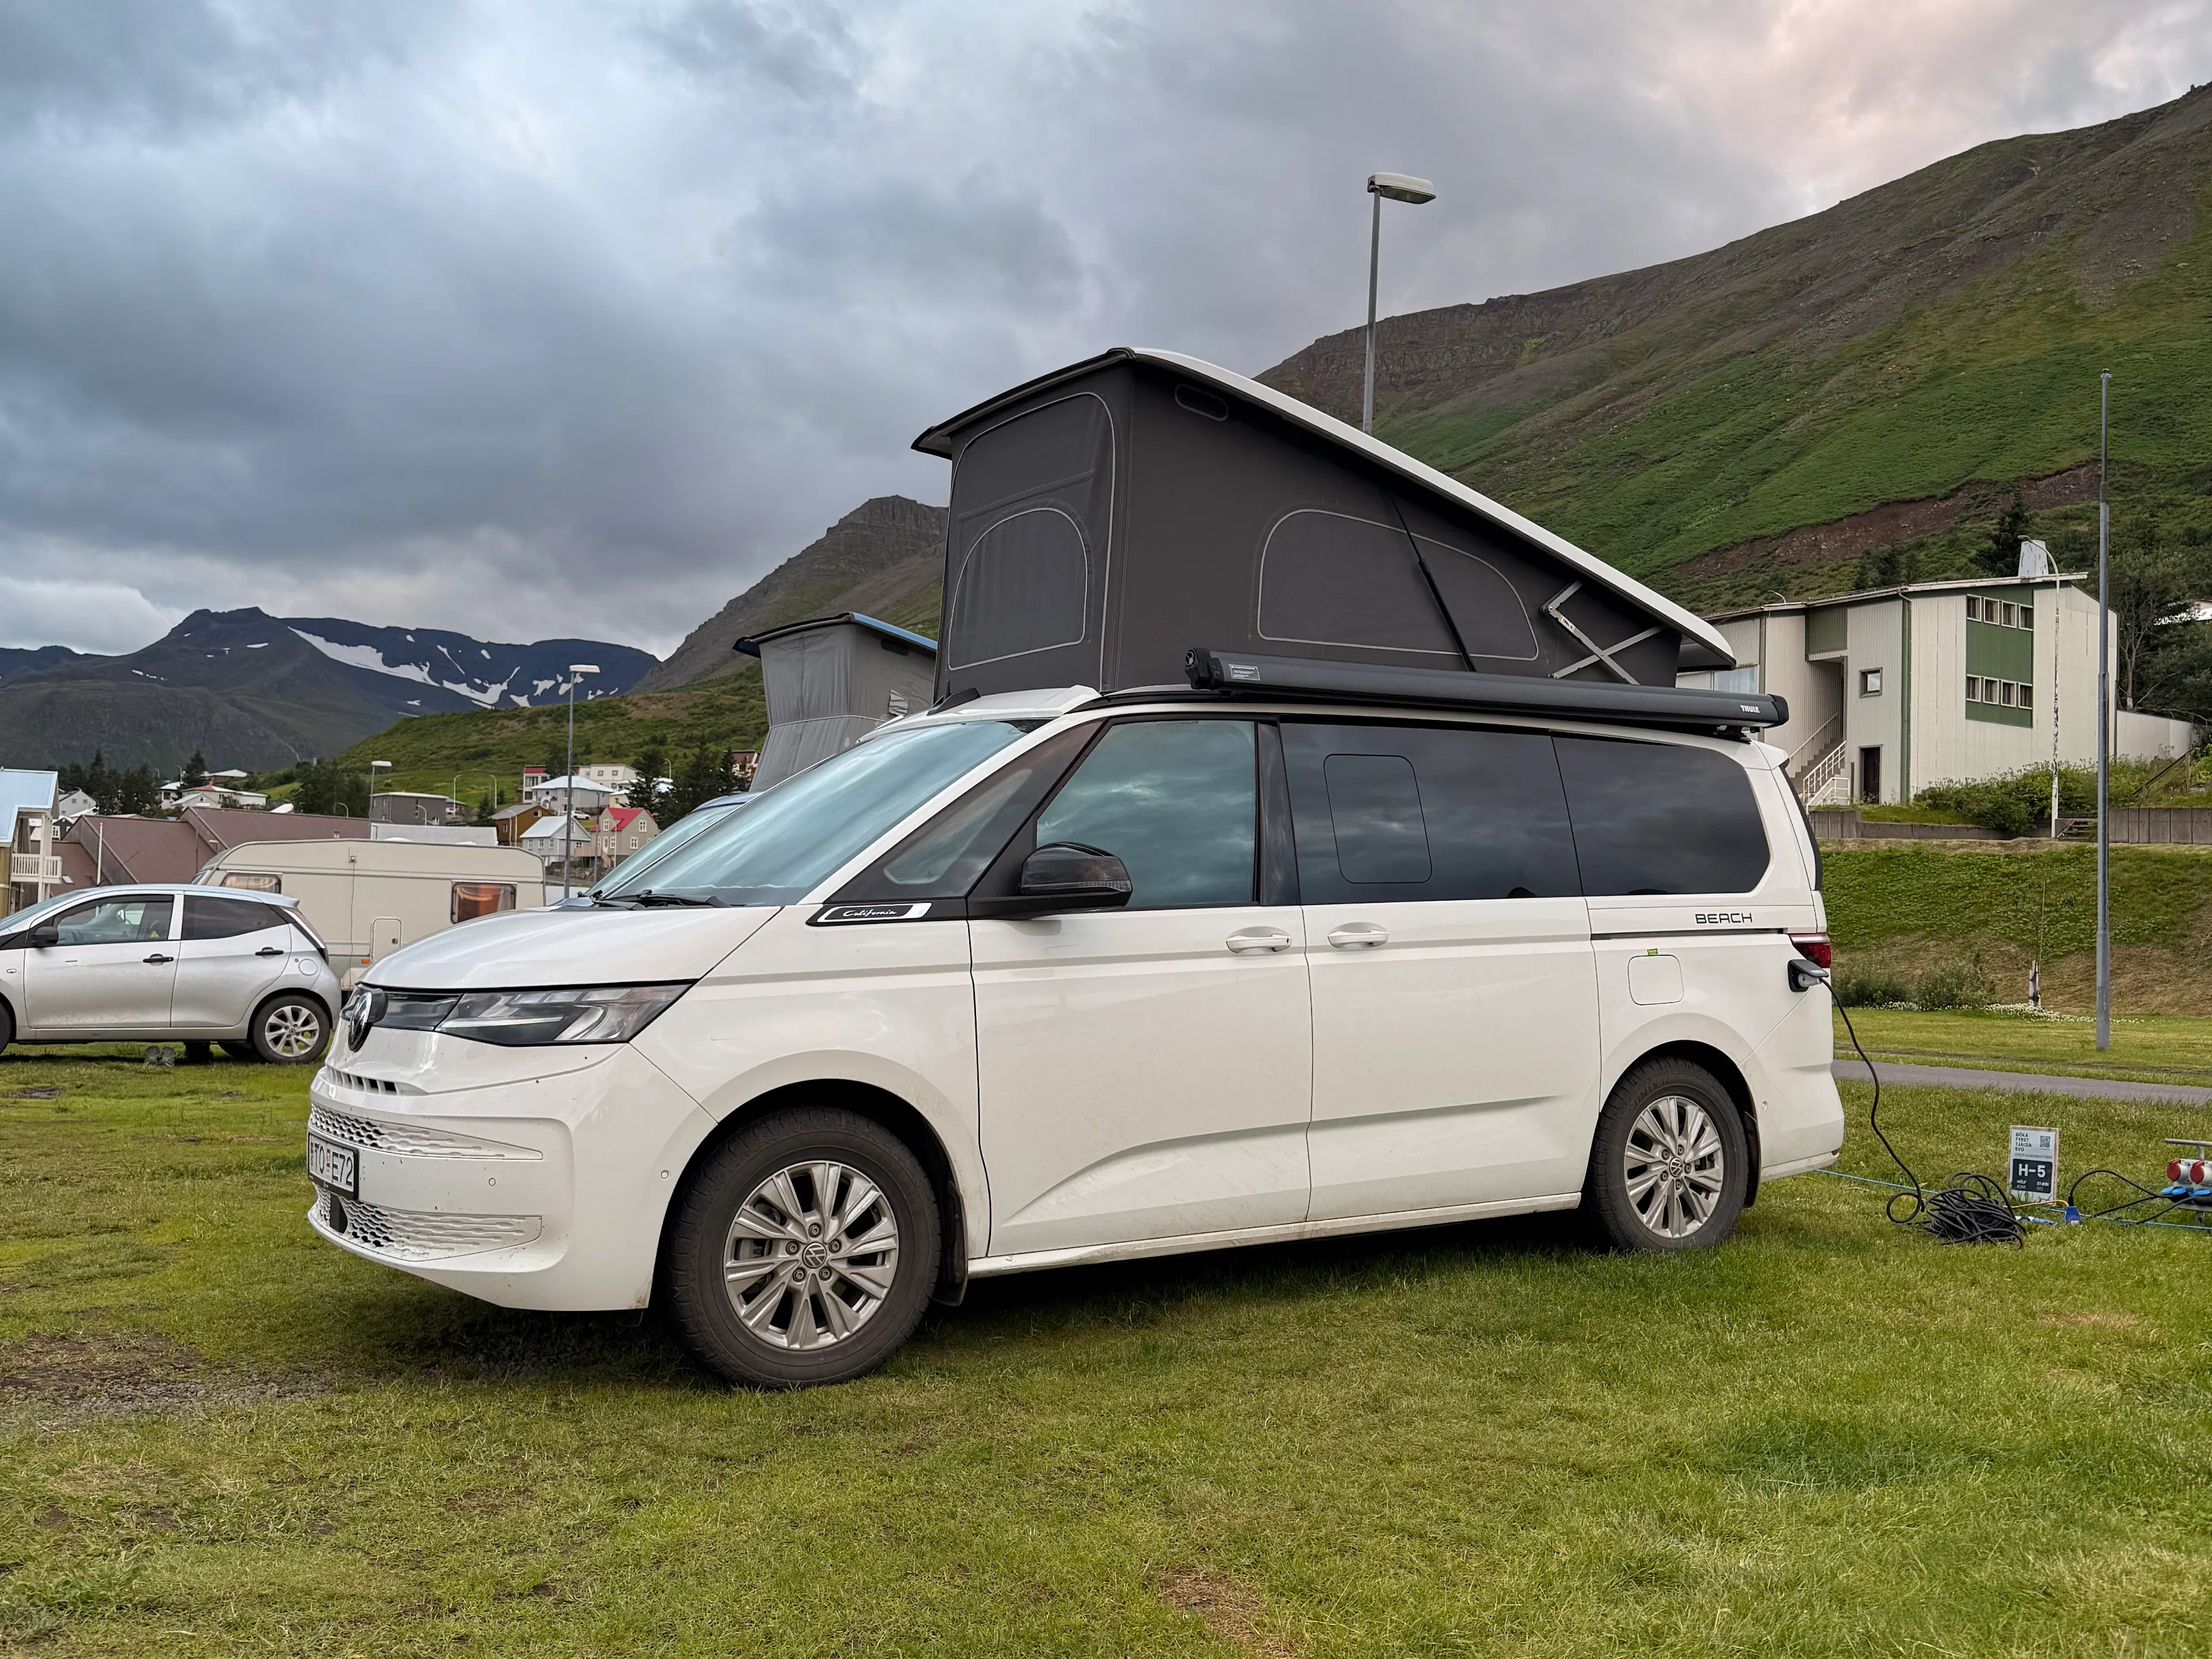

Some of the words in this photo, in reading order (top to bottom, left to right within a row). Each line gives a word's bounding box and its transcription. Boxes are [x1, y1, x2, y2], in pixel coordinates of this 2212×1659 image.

[1740, 704, 1760, 714] THULE
[843, 908, 897, 917] California
[1695, 912, 1753, 924] BEACH
[332, 1151, 353, 1187] E72
[2018, 1163, 2046, 1178] H-5
